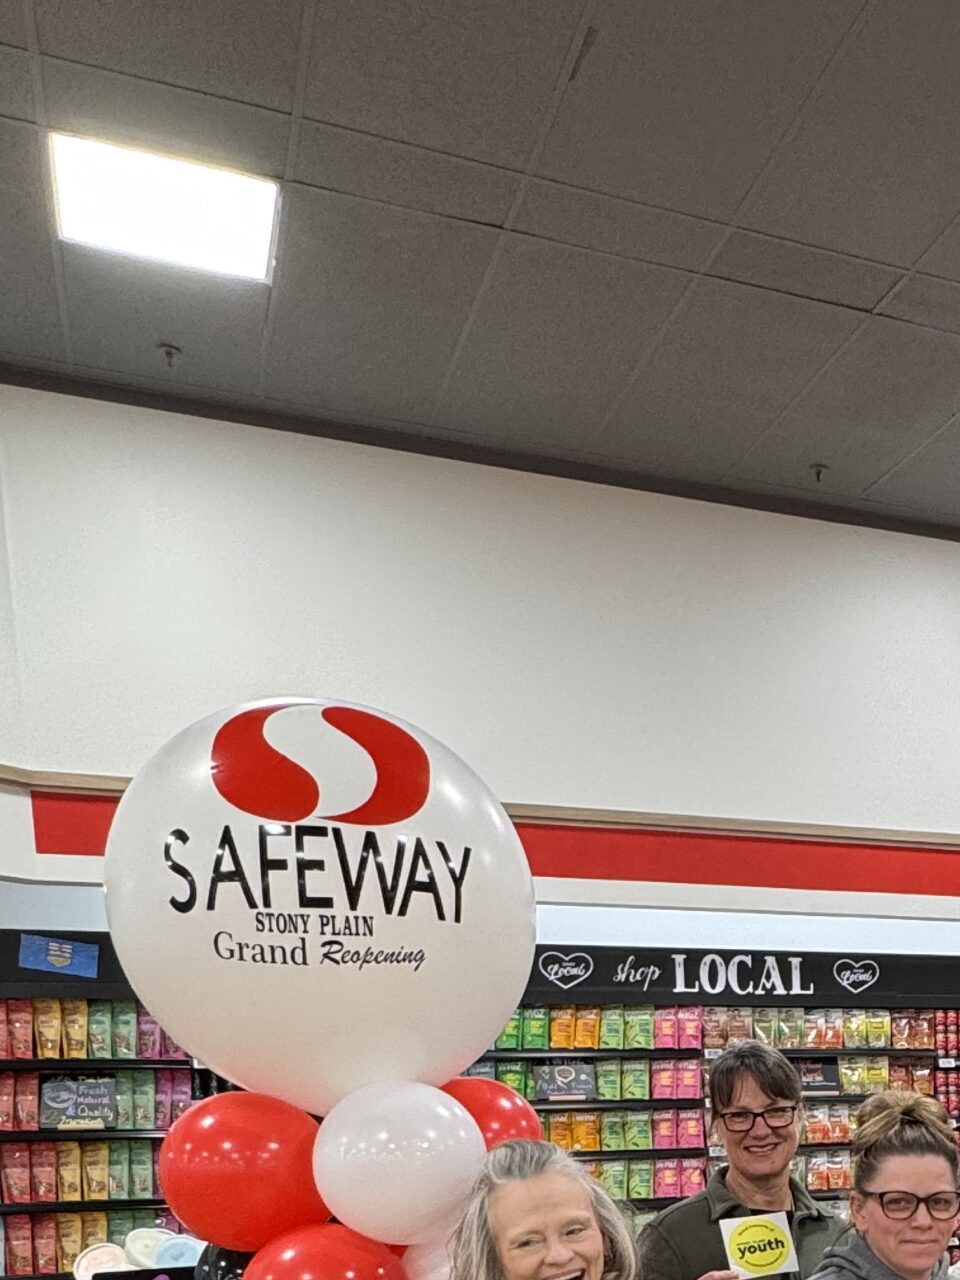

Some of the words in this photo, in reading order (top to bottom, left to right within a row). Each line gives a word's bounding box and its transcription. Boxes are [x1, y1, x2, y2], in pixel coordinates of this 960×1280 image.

[164, 824, 473, 924] SAFEWAY
[255, 911, 310, 934] STONY
[319, 914, 374, 937] PLAIN
[213, 930, 310, 966] Grand
[320, 940, 426, 972] Reopening
[613, 955, 662, 991] shop
[671, 953, 815, 995] LOCAL
[77, 1105, 114, 1121] Quality
[737, 1237, 785, 1260] youth
